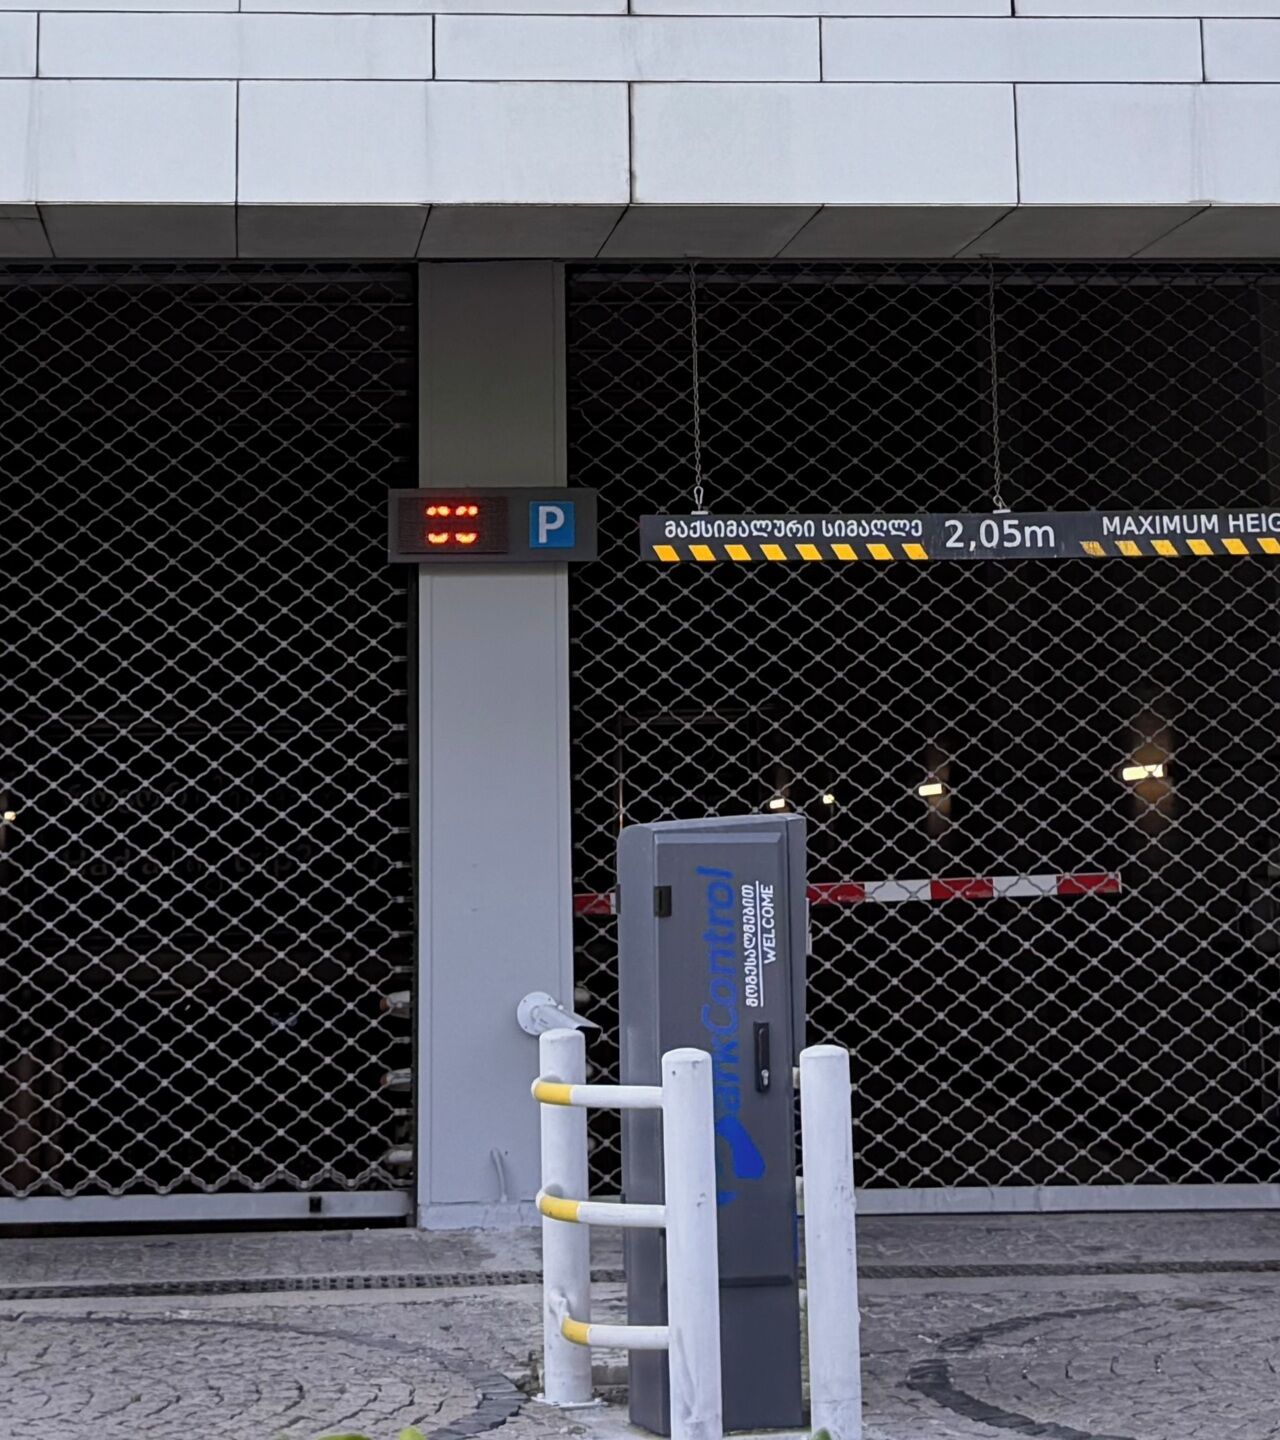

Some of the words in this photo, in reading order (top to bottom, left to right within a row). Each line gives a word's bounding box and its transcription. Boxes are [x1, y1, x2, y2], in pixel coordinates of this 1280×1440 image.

[538, 505, 566, 544] P
[664, 519, 815, 538] მაქსიმალური
[822, 519, 923, 538] სიმაღლე
[944, 519, 1055, 552] 2,05m
[1102, 513, 1219, 536] MAXIMUM
[760, 884, 777, 965] WELCOME
